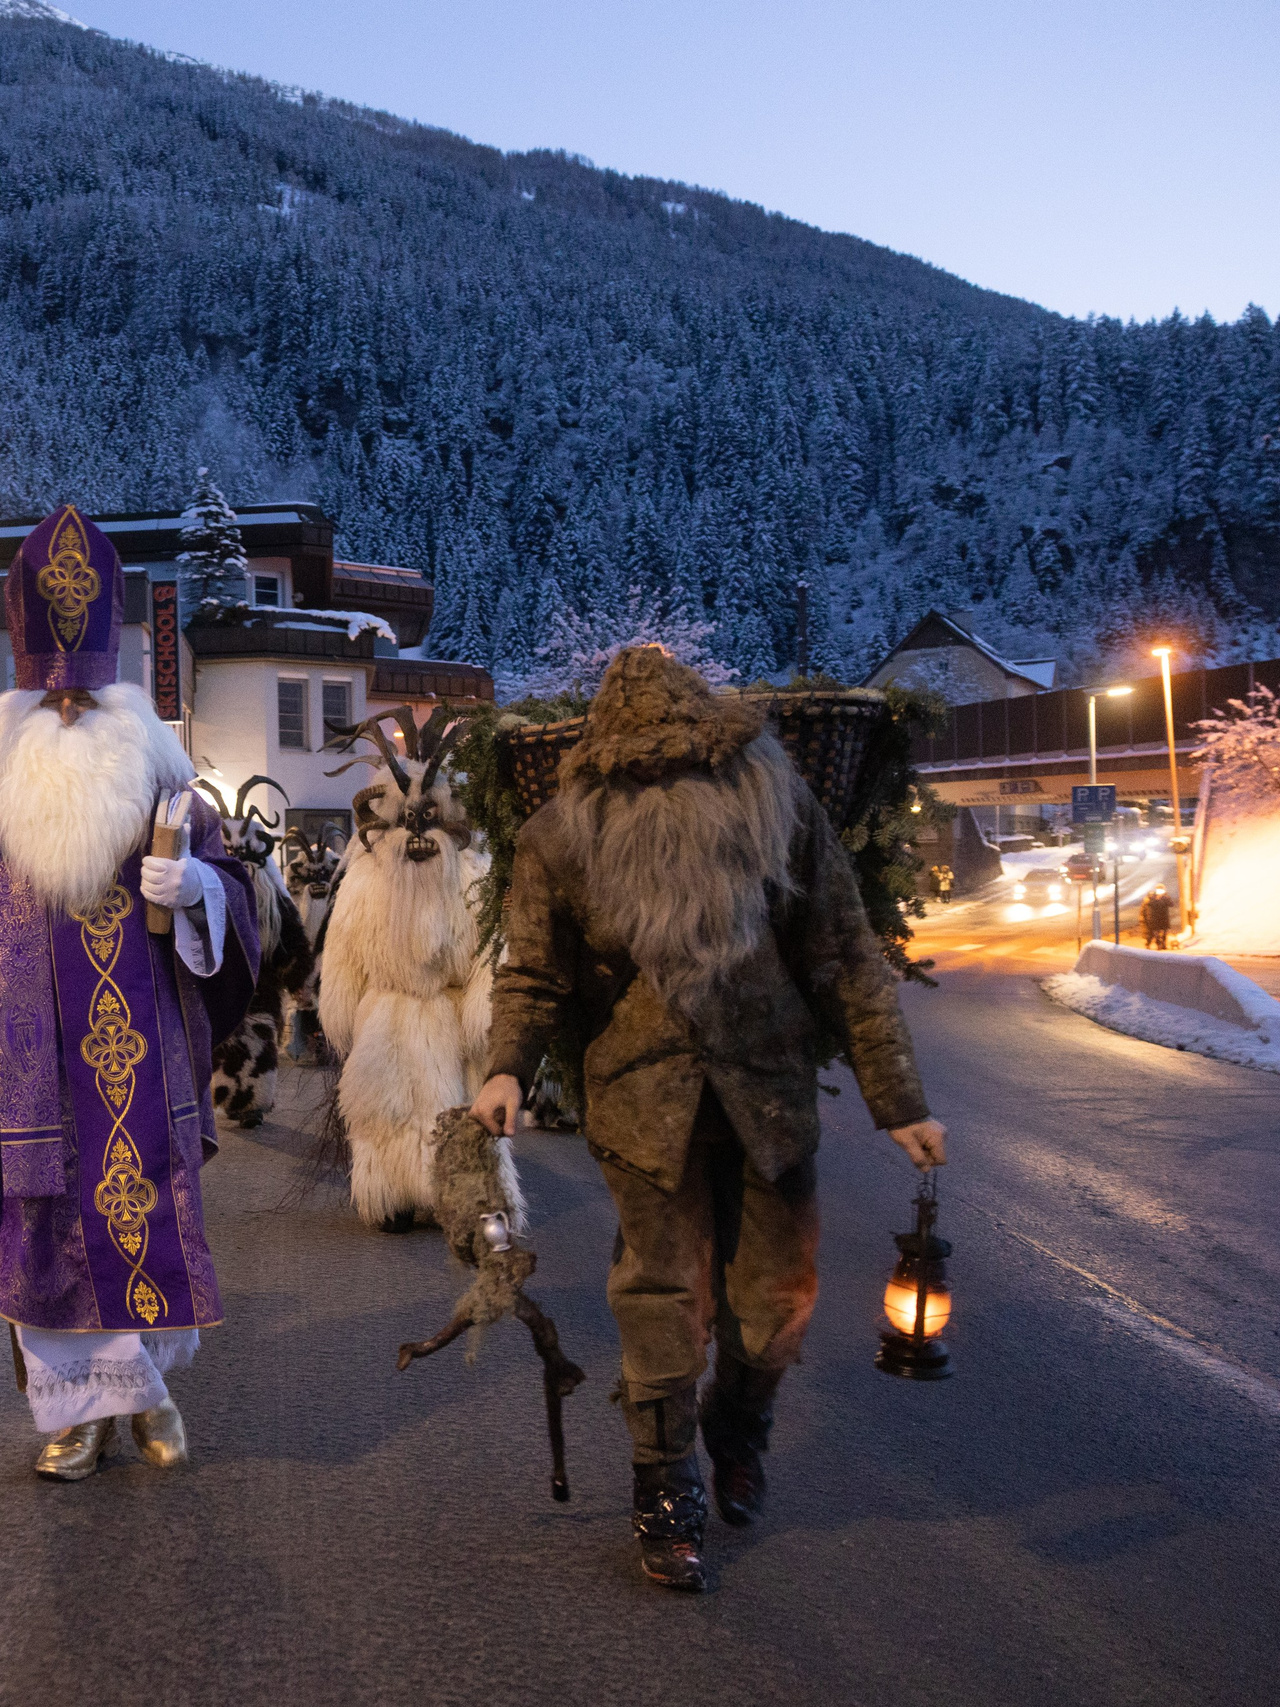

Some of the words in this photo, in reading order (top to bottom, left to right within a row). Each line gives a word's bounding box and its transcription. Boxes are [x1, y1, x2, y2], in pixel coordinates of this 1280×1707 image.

[157, 603, 177, 718] SKISCHOOL
[1077, 788, 1090, 802] P
[1098, 787, 1111, 801] P
